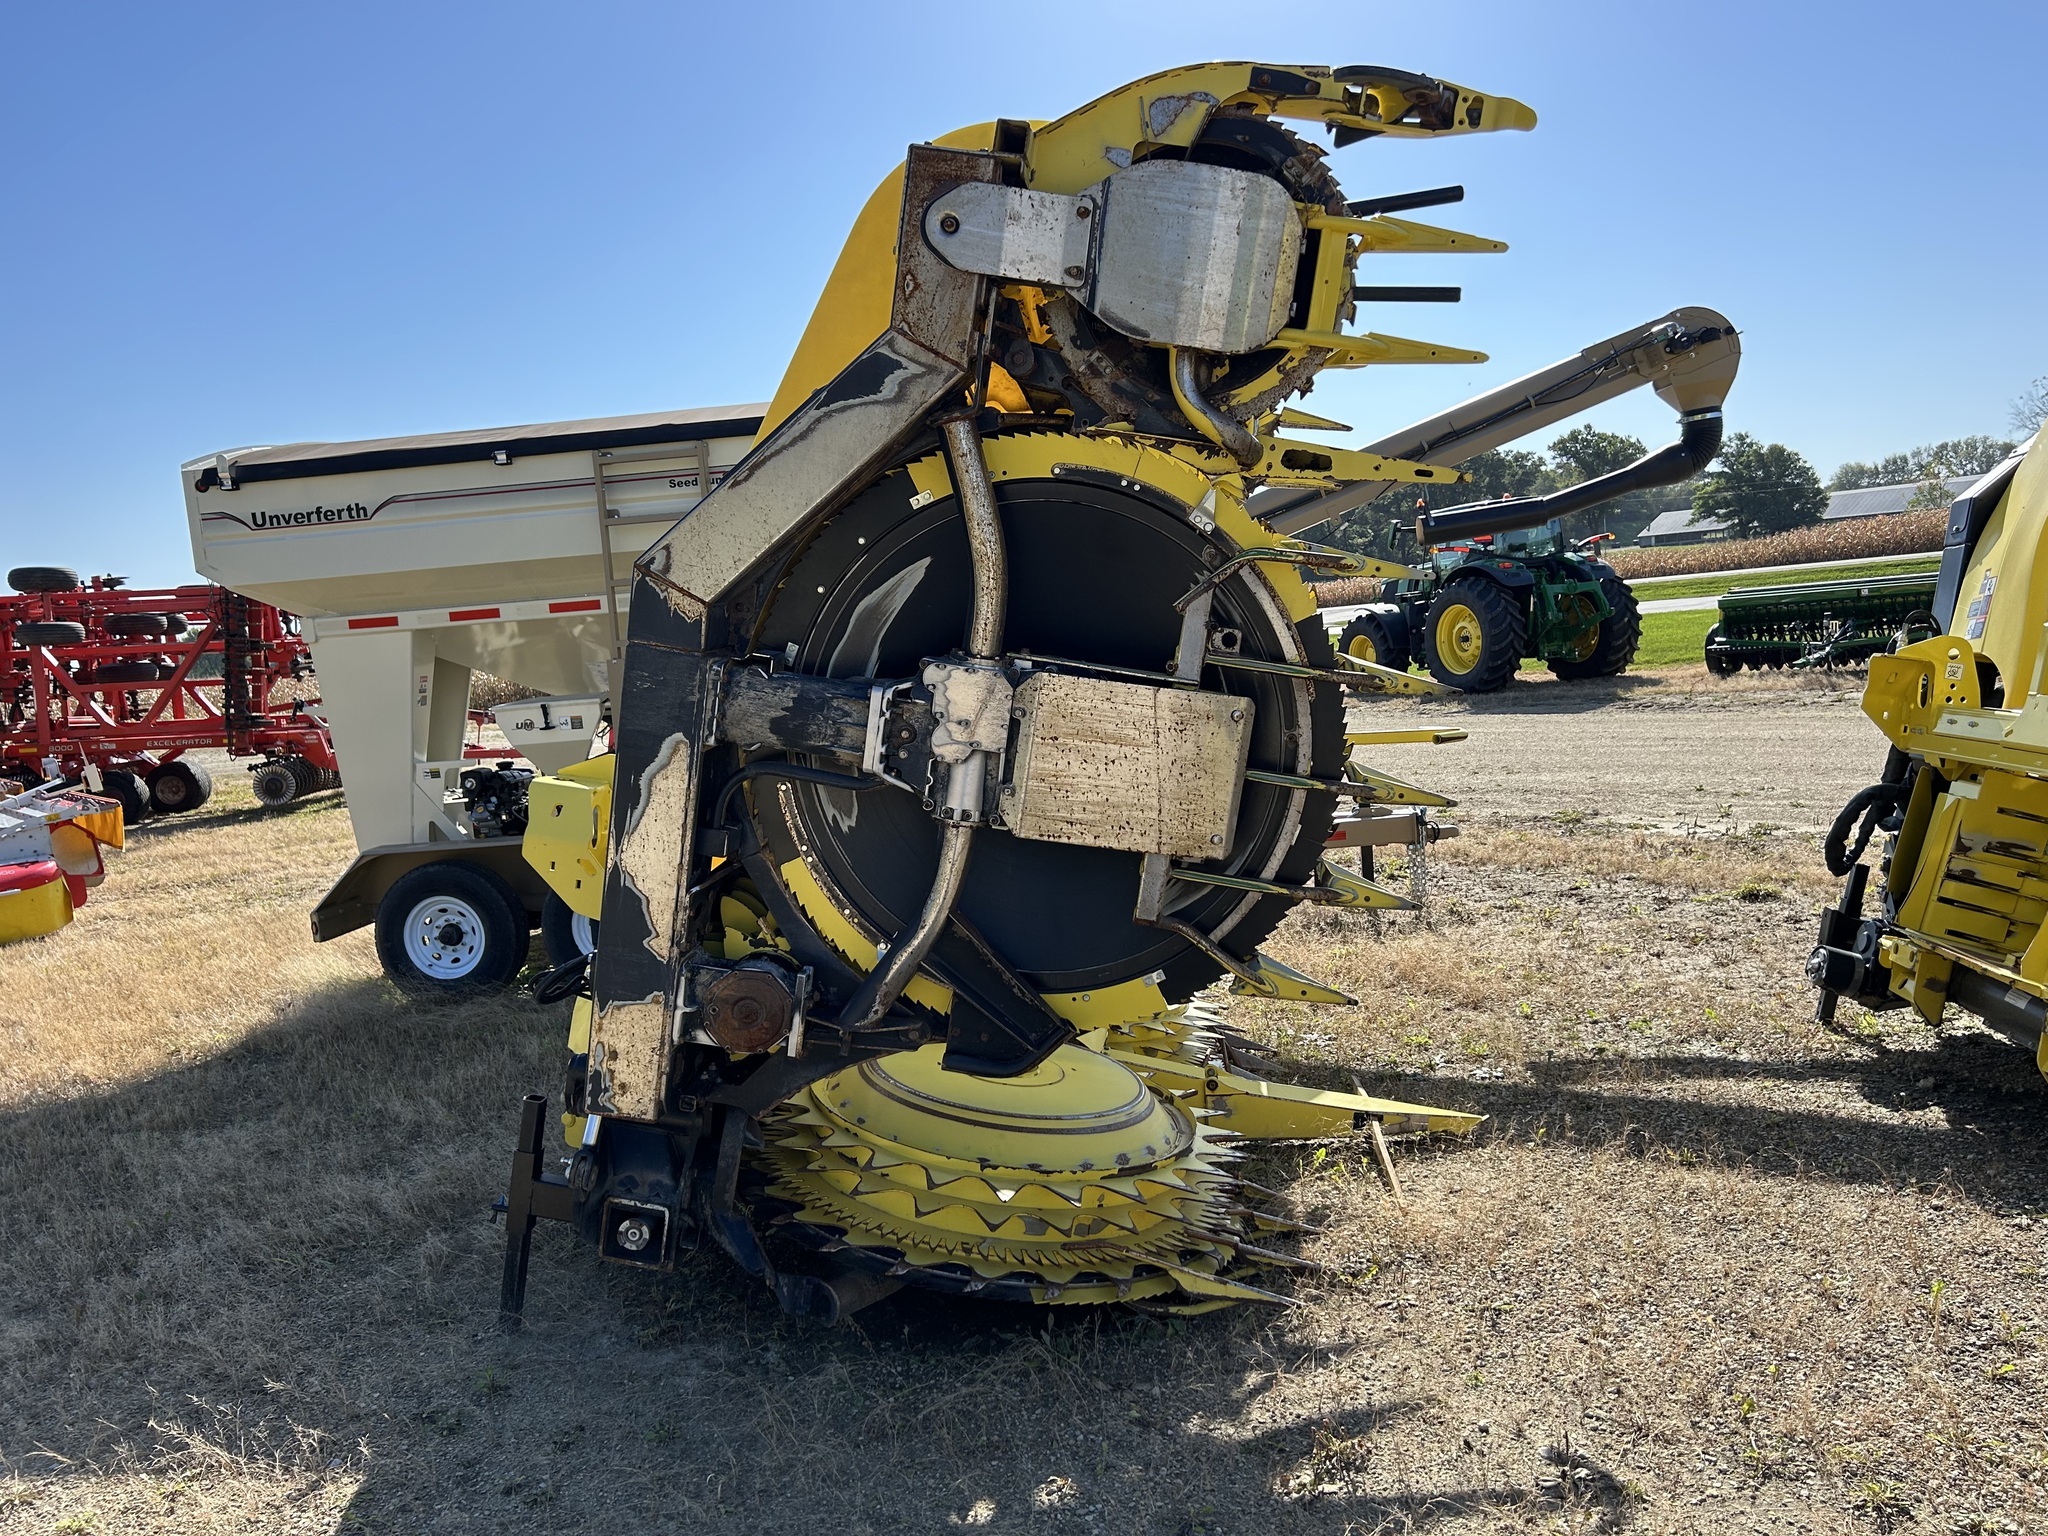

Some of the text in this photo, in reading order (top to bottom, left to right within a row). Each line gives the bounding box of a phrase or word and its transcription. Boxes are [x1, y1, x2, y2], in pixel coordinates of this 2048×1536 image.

[669, 477, 698, 488] Seed
[251, 503, 368, 528] Unverferth
[146, 738, 212, 747] EXCELERATOR
[49, 744, 73, 752] 8000
